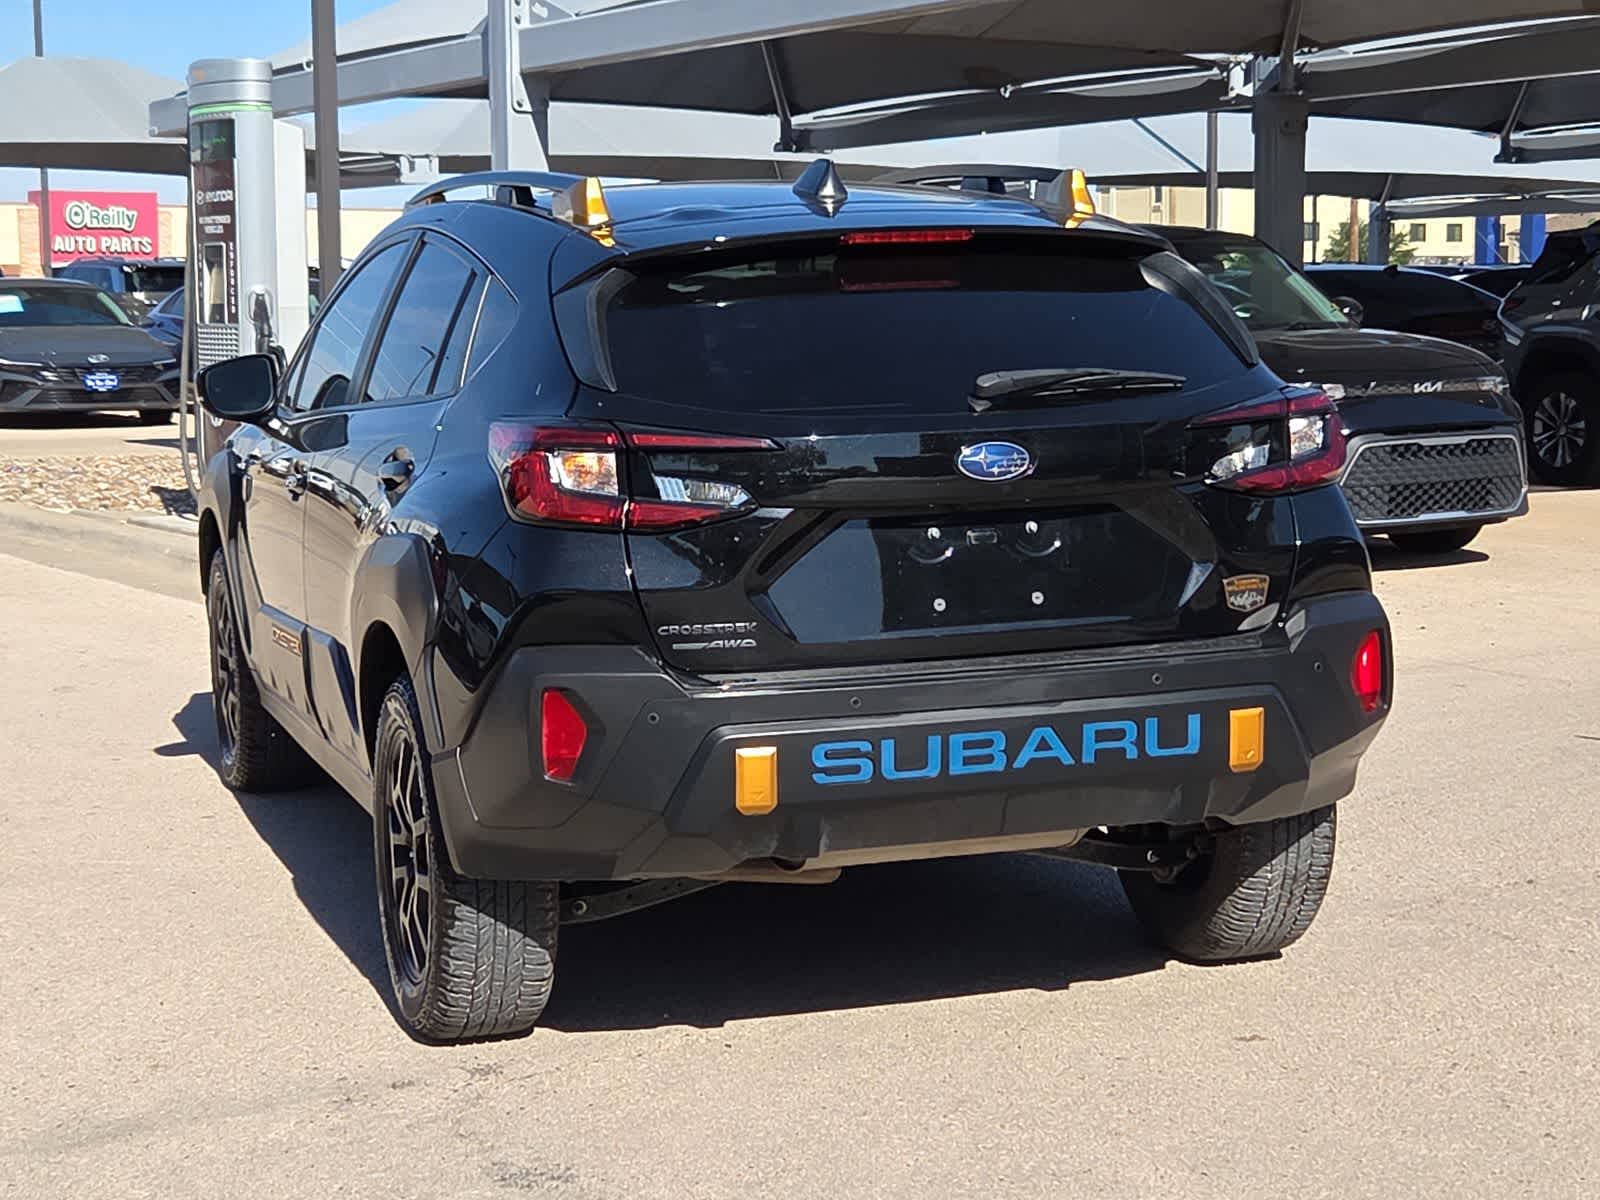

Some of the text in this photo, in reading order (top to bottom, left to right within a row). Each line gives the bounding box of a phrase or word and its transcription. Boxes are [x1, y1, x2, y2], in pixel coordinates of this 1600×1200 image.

[67, 202, 136, 230] O'Reilly
[53, 235, 153, 254] AUTO PARTS
[657, 622, 758, 636] CROSSTREK
[707, 638, 758, 649] AWD
[811, 713, 1202, 785] SUBARU
